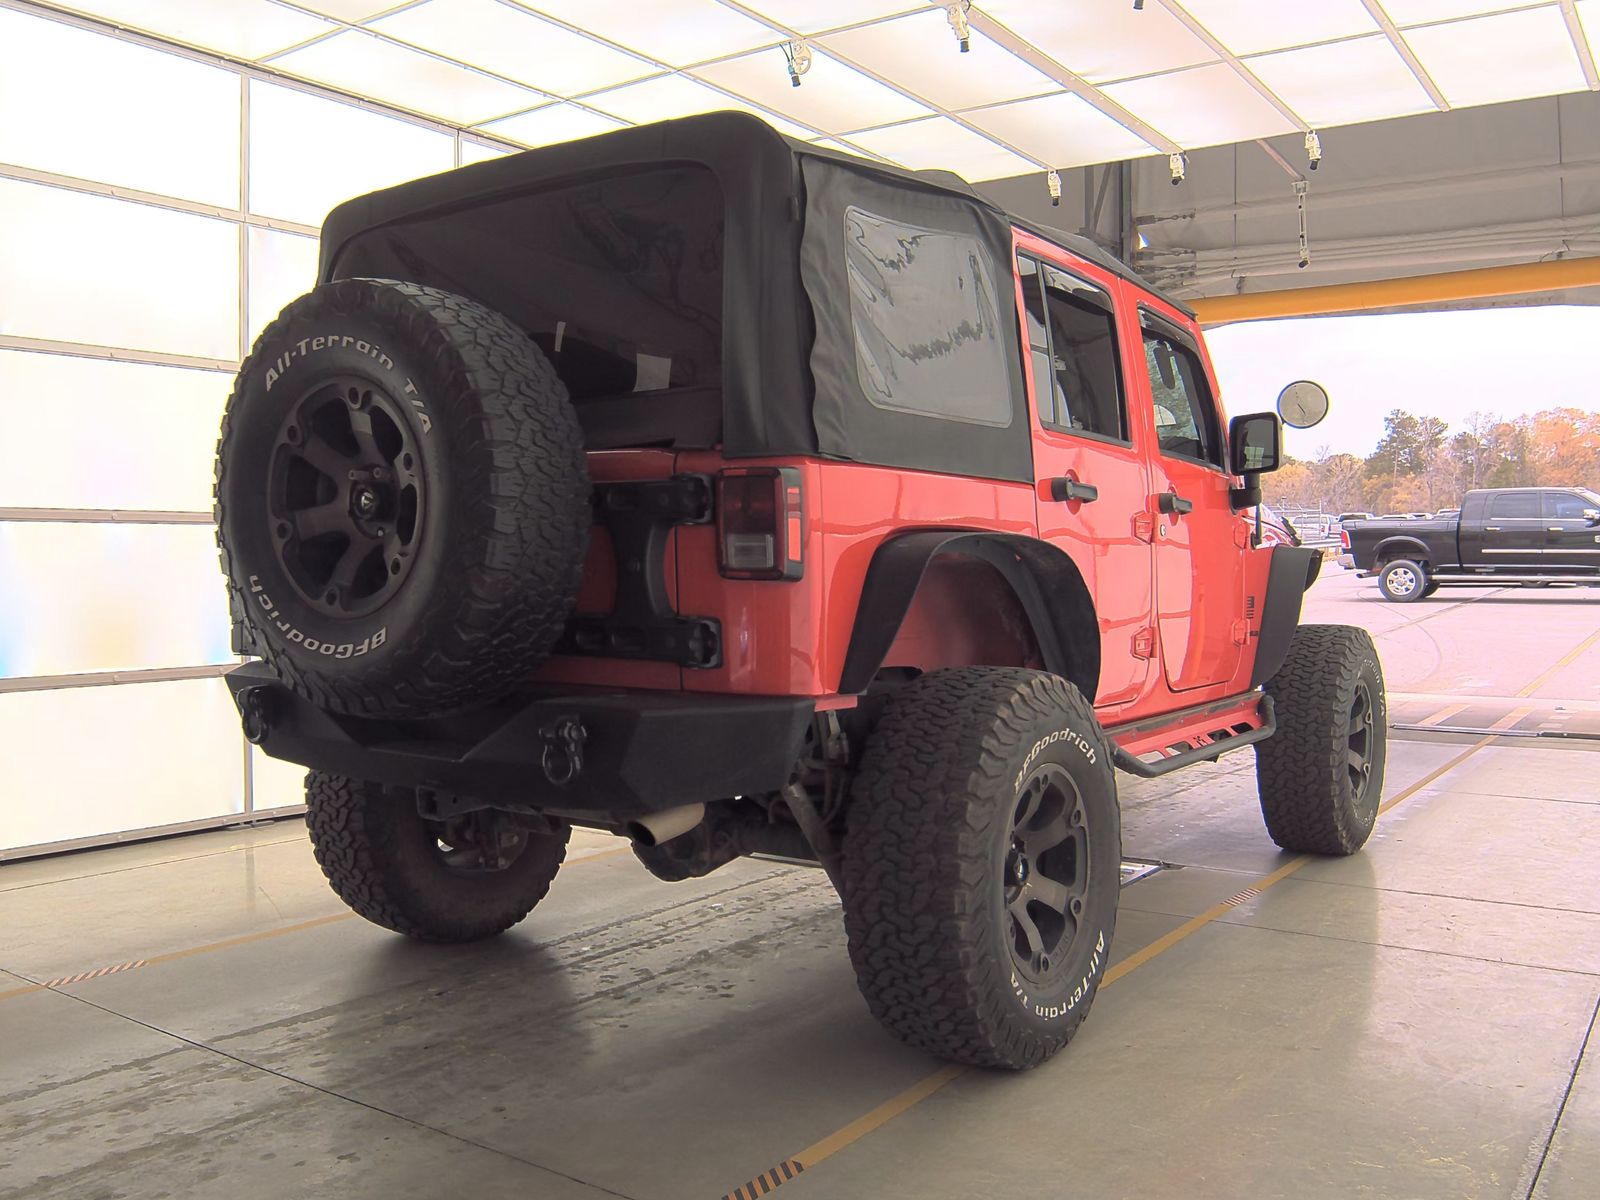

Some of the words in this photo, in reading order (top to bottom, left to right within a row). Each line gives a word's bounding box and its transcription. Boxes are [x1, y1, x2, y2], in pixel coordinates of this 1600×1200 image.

[265, 335, 395, 392] All-Terrain
[404, 377, 433, 434] T/A
[249, 575, 387, 659] BFGoodrich
[1014, 727, 1097, 795] BFGoodrich
[1010, 971, 1028, 1009] T/A
[1035, 929, 1105, 1021] All-Terrain
